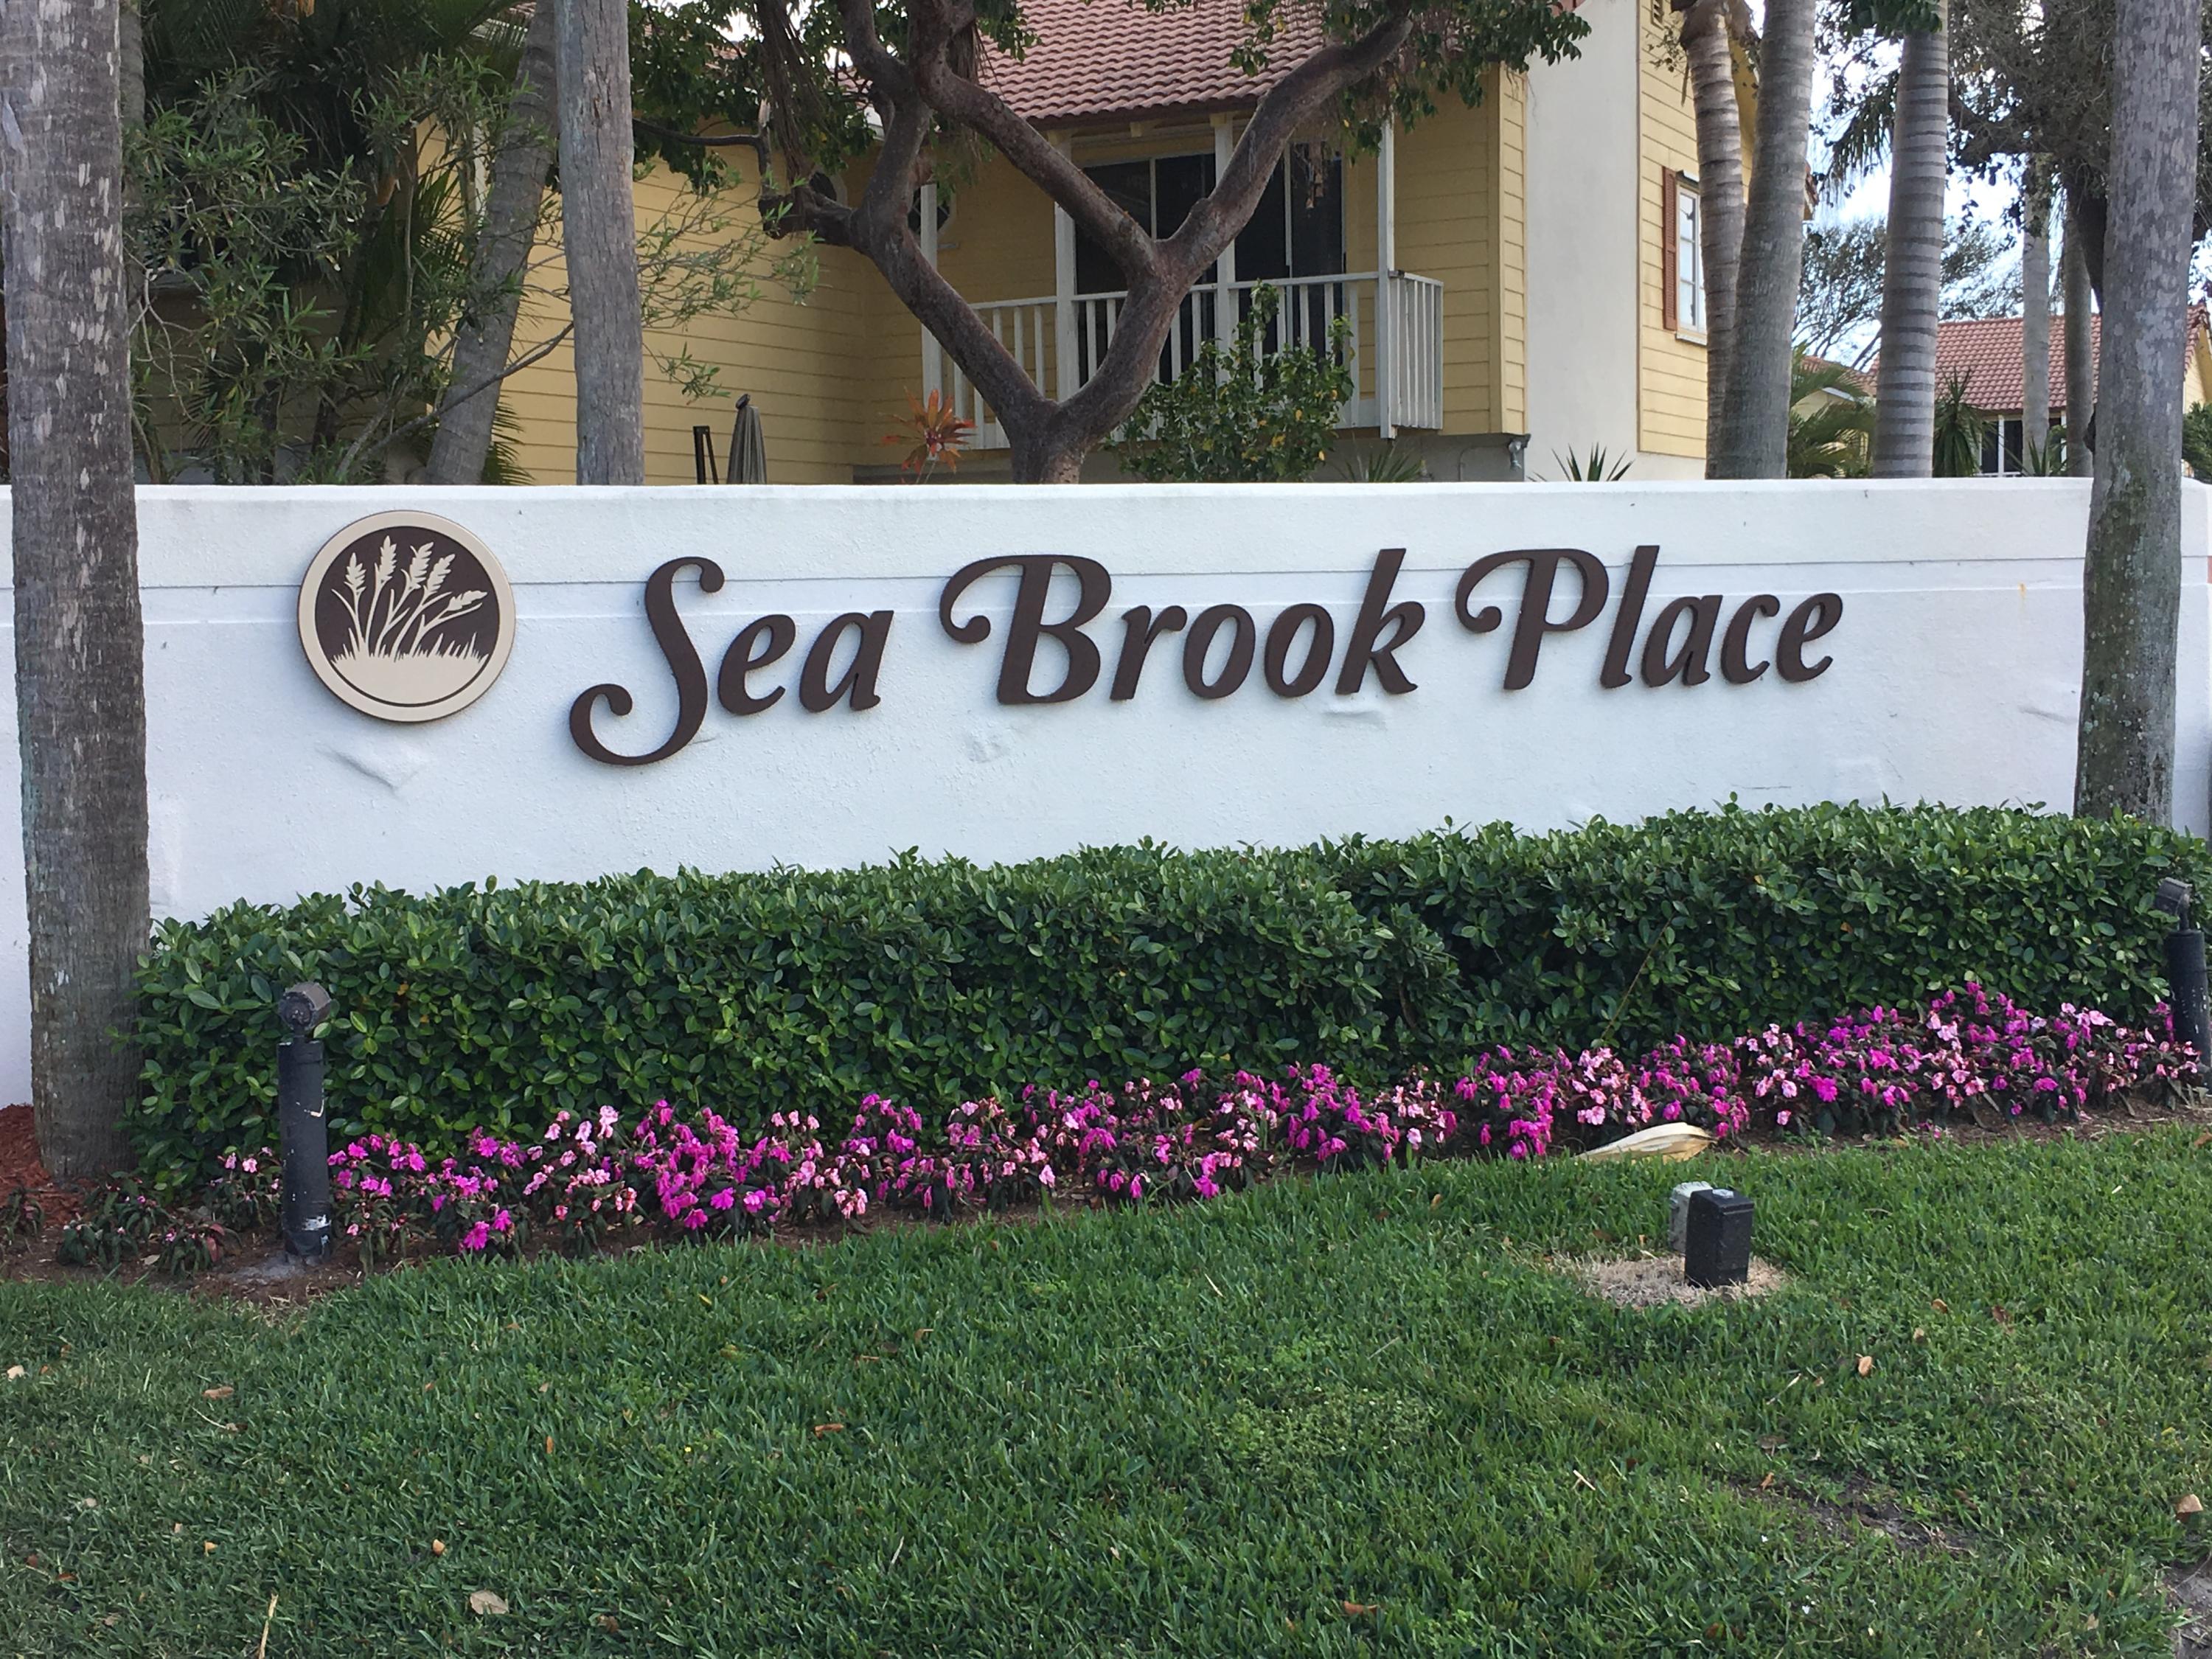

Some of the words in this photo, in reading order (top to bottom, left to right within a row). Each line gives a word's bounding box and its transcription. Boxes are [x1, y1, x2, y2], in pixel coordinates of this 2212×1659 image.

[567, 557, 894, 768] Sea
[939, 549, 1426, 706] Brook
[1455, 546, 1843, 692] Place
